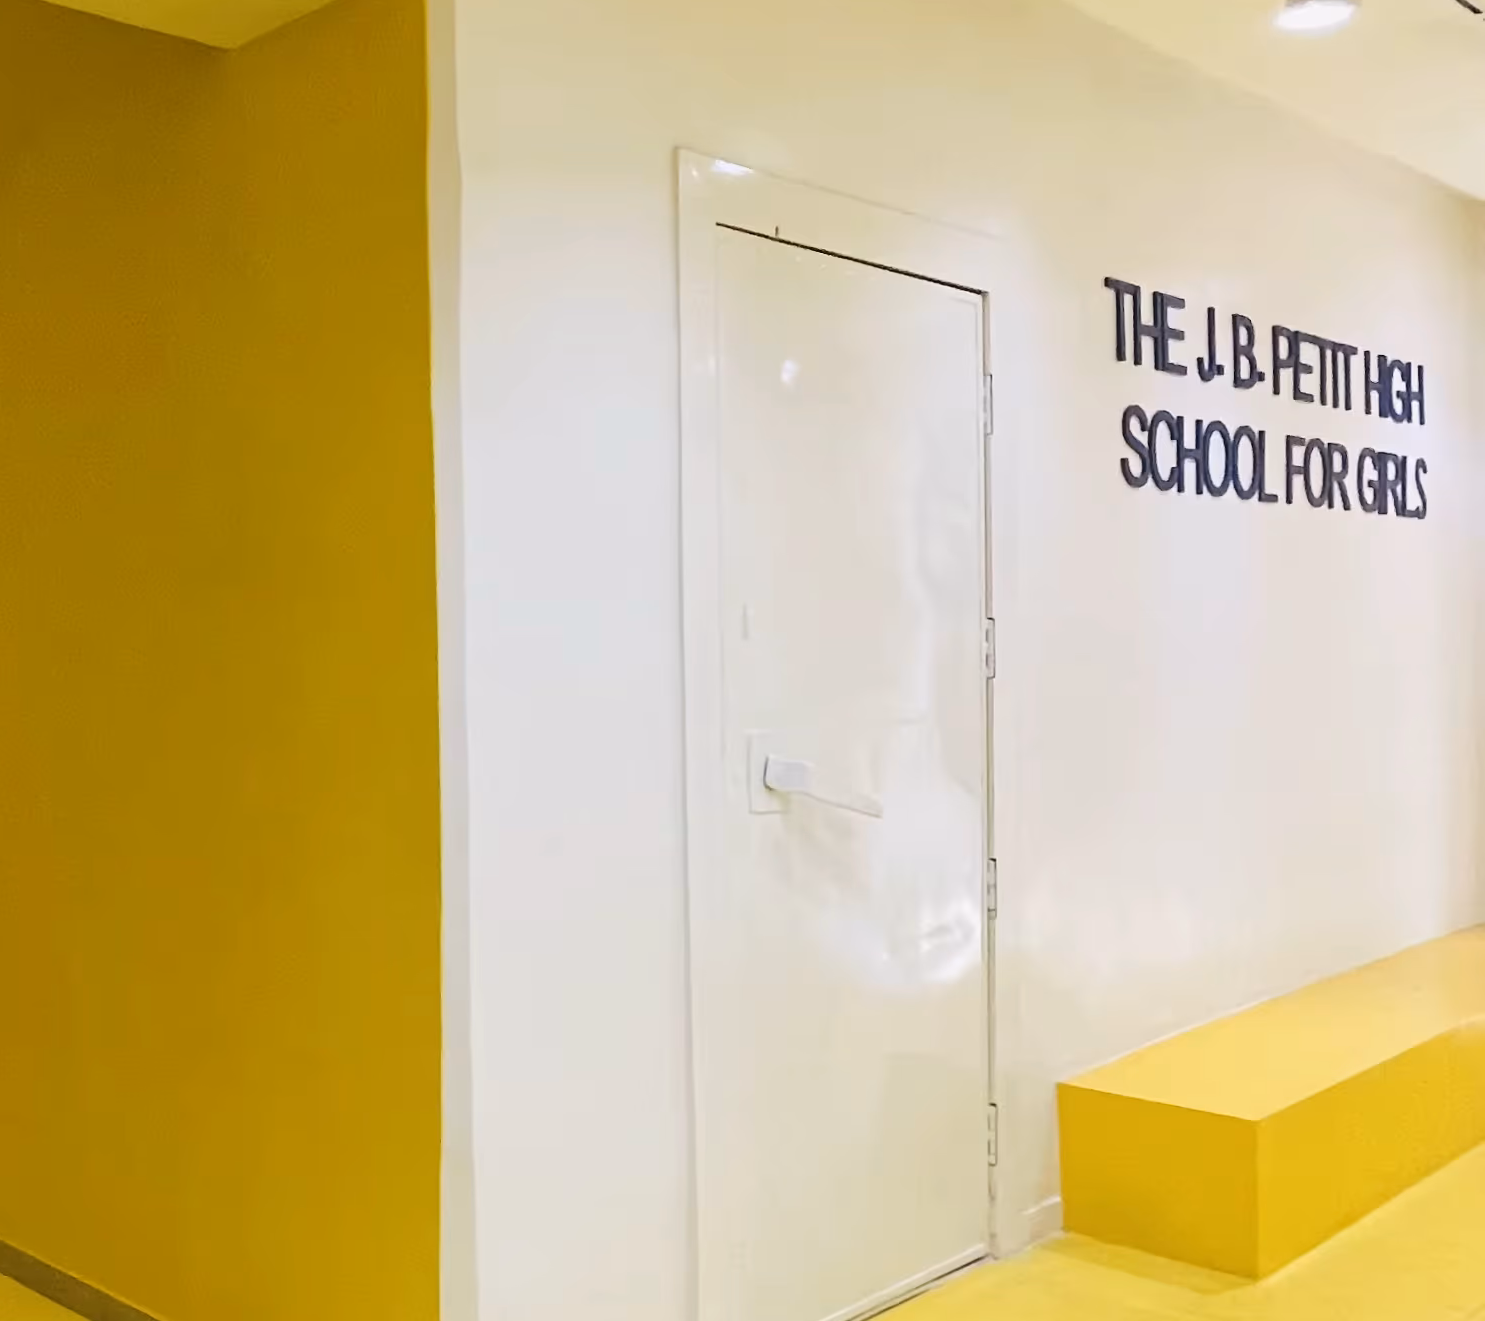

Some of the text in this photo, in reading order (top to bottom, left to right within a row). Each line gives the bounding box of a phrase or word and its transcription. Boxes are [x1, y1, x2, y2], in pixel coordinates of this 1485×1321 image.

[1103, 276, 1426, 426] THE J. B. PETIT HIGH
[1120, 404, 1428, 520] SCHOOL FOR GIRLS
